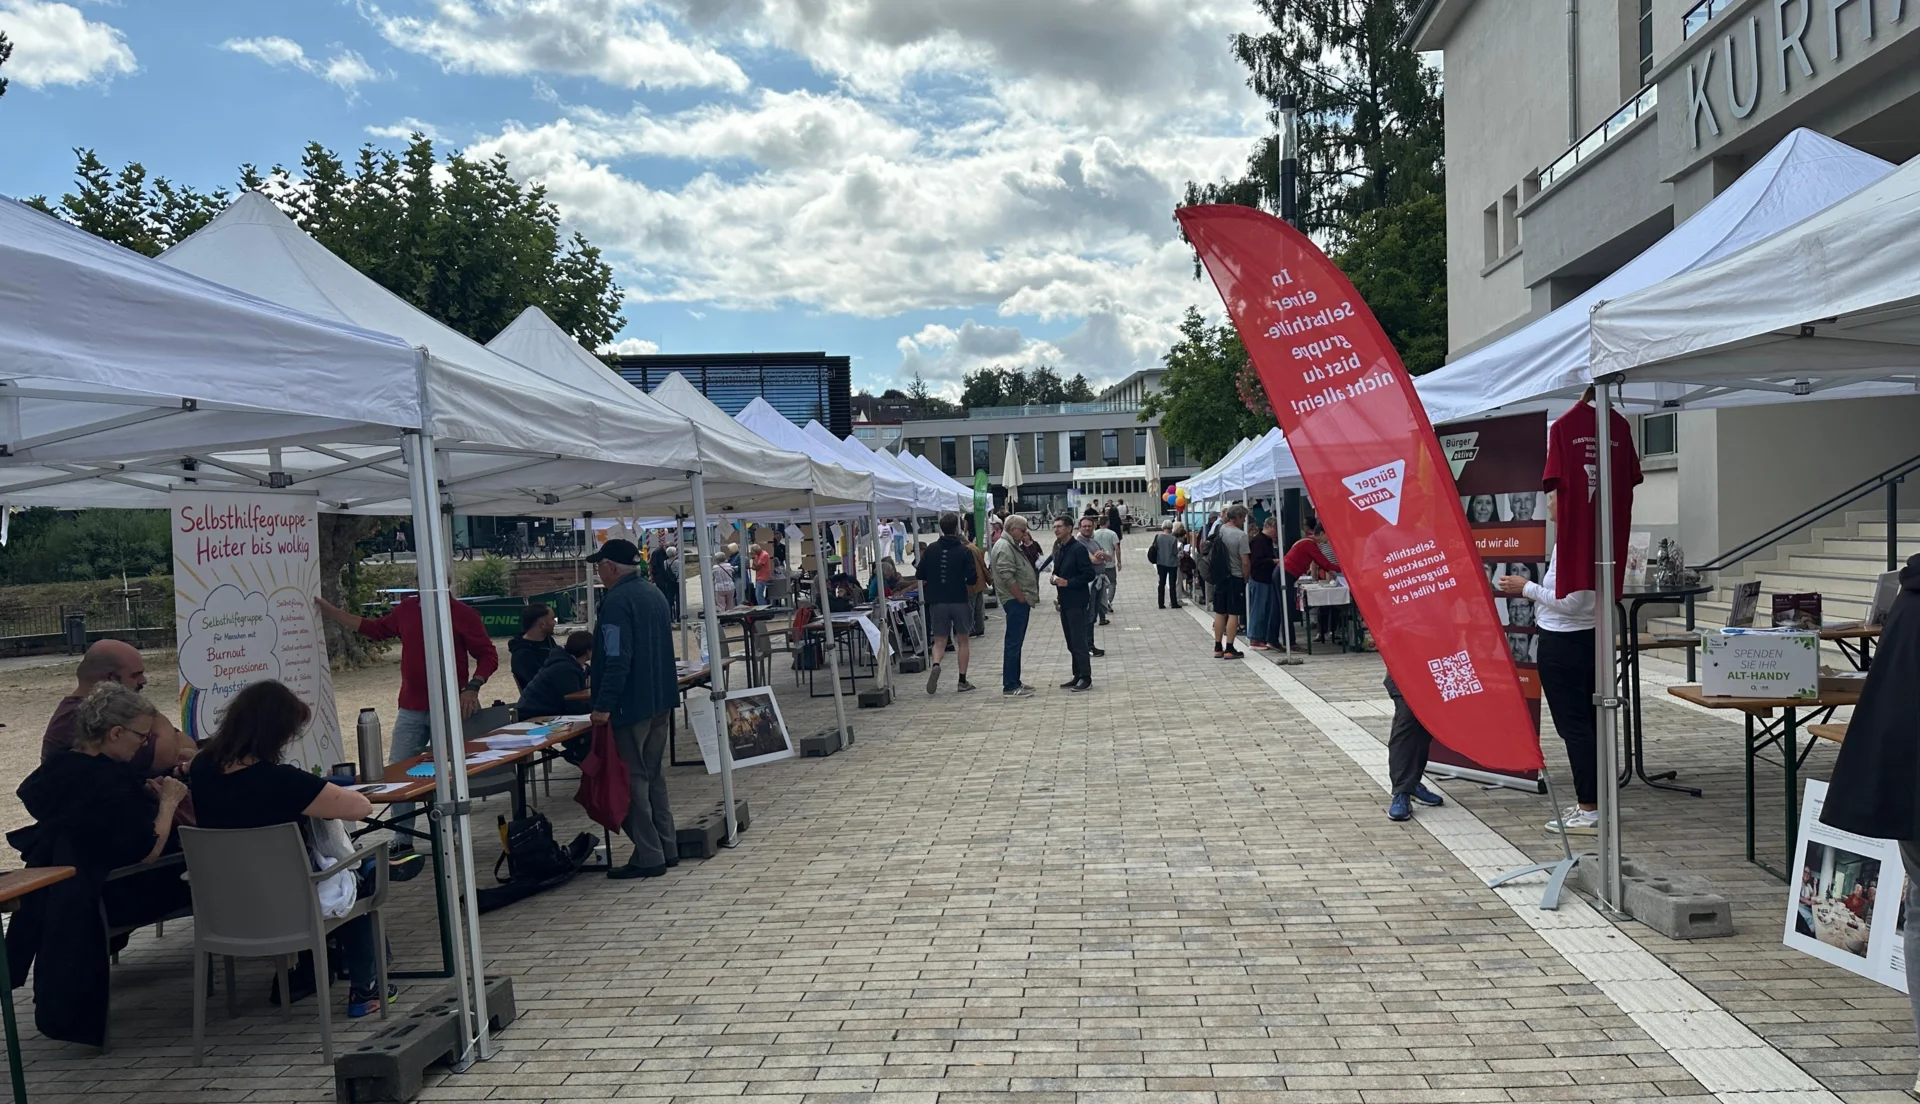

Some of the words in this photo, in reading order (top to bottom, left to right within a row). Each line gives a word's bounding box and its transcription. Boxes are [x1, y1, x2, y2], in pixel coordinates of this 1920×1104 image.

[1687, 0, 1902, 149] KURH
[1446, 438, 1472, 448] Bürger
[1453, 450, 1473, 459] aktive
[1488, 537, 1502, 548] wir
[1504, 537, 1519, 547] alle
[197, 535, 246, 565] Heiter
[252, 534, 272, 555] bis
[278, 534, 309, 562] wolkig
[202, 611, 263, 630] Selbsthilfegruppe
[213, 633, 222, 644] für
[224, 632, 246, 640] Menschen
[248, 631, 256, 639] mit
[206, 645, 246, 662] Burnout
[1733, 649, 1784, 659] SPENDEN
[213, 662, 268, 680] Depressionen
[1740, 660, 1756, 669] SIE
[1758, 660, 1777, 669] IHR
[1727, 671, 1790, 680] ALT-HANDY
[211, 680, 250, 698] Angststö
